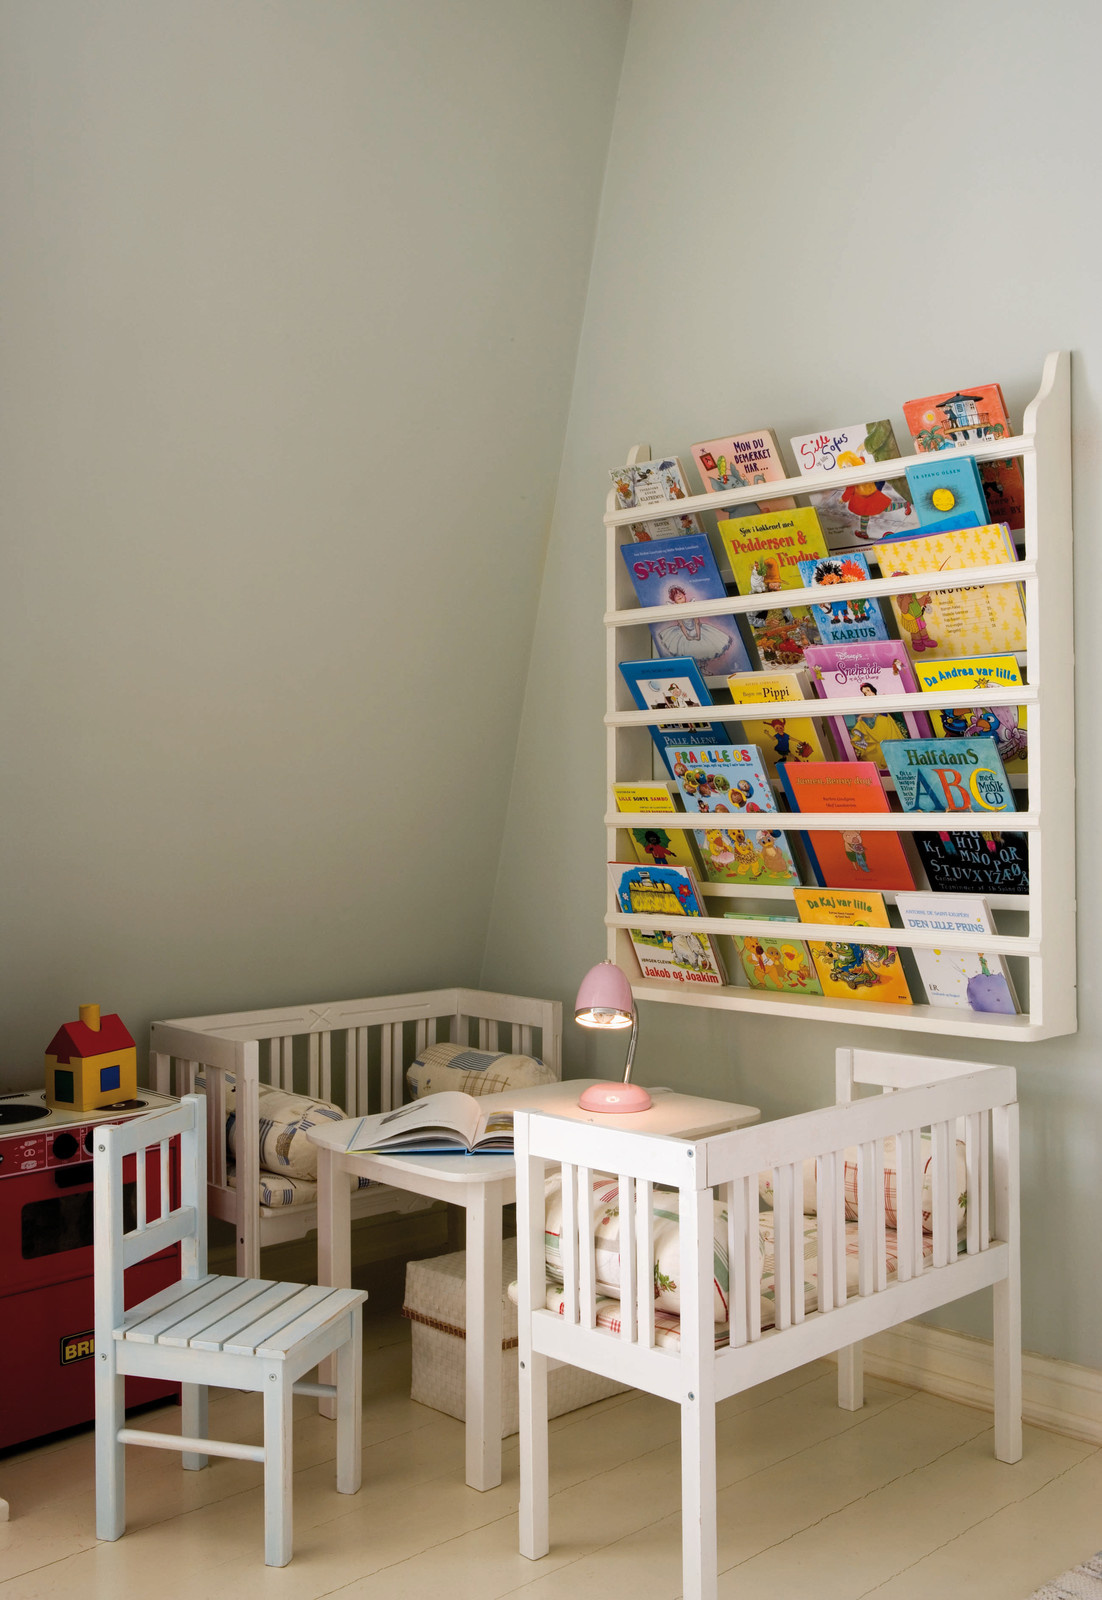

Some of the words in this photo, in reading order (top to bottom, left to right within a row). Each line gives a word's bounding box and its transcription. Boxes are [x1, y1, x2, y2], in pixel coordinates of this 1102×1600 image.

[733, 441, 752, 453] MON
[752, 438, 764, 449] DU
[822, 433, 848, 471] Sofus
[734, 448, 771, 464] BEMÆRKET
[744, 462, 760, 474] HAR
[941, 468, 961, 476] OLSEN
[730, 536, 795, 555] Peddersen
[796, 530, 808, 545] &
[776, 550, 820, 568] Findus
[831, 627, 876, 641] KARIUS
[923, 676, 938, 687] Da
[938, 667, 974, 682] Andrea
[975, 667, 994, 677] var
[996, 667, 1018, 682] lille
[762, 686, 790, 700] Pippi
[690, 736, 719, 745] ALENE
[674, 751, 698, 764] FRA
[700, 750, 731, 764] ALLE
[733, 749, 752, 762] OS
[908, 768, 1008, 811] ABC
[984, 793, 1004, 805] CD
[806, 899, 820, 910] Da
[819, 896, 836, 909] Kaj
[836, 899, 852, 908] var
[854, 899, 873, 913] lille
[908, 919, 929, 929] DEN
[930, 920, 956, 931] LILLE
[955, 922, 985, 933] PRINS
[645, 966, 671, 979] Jakob
[672, 971, 685, 982] og
[686, 971, 720, 984] Joakim
[65, 1339, 95, 1361] BRI
